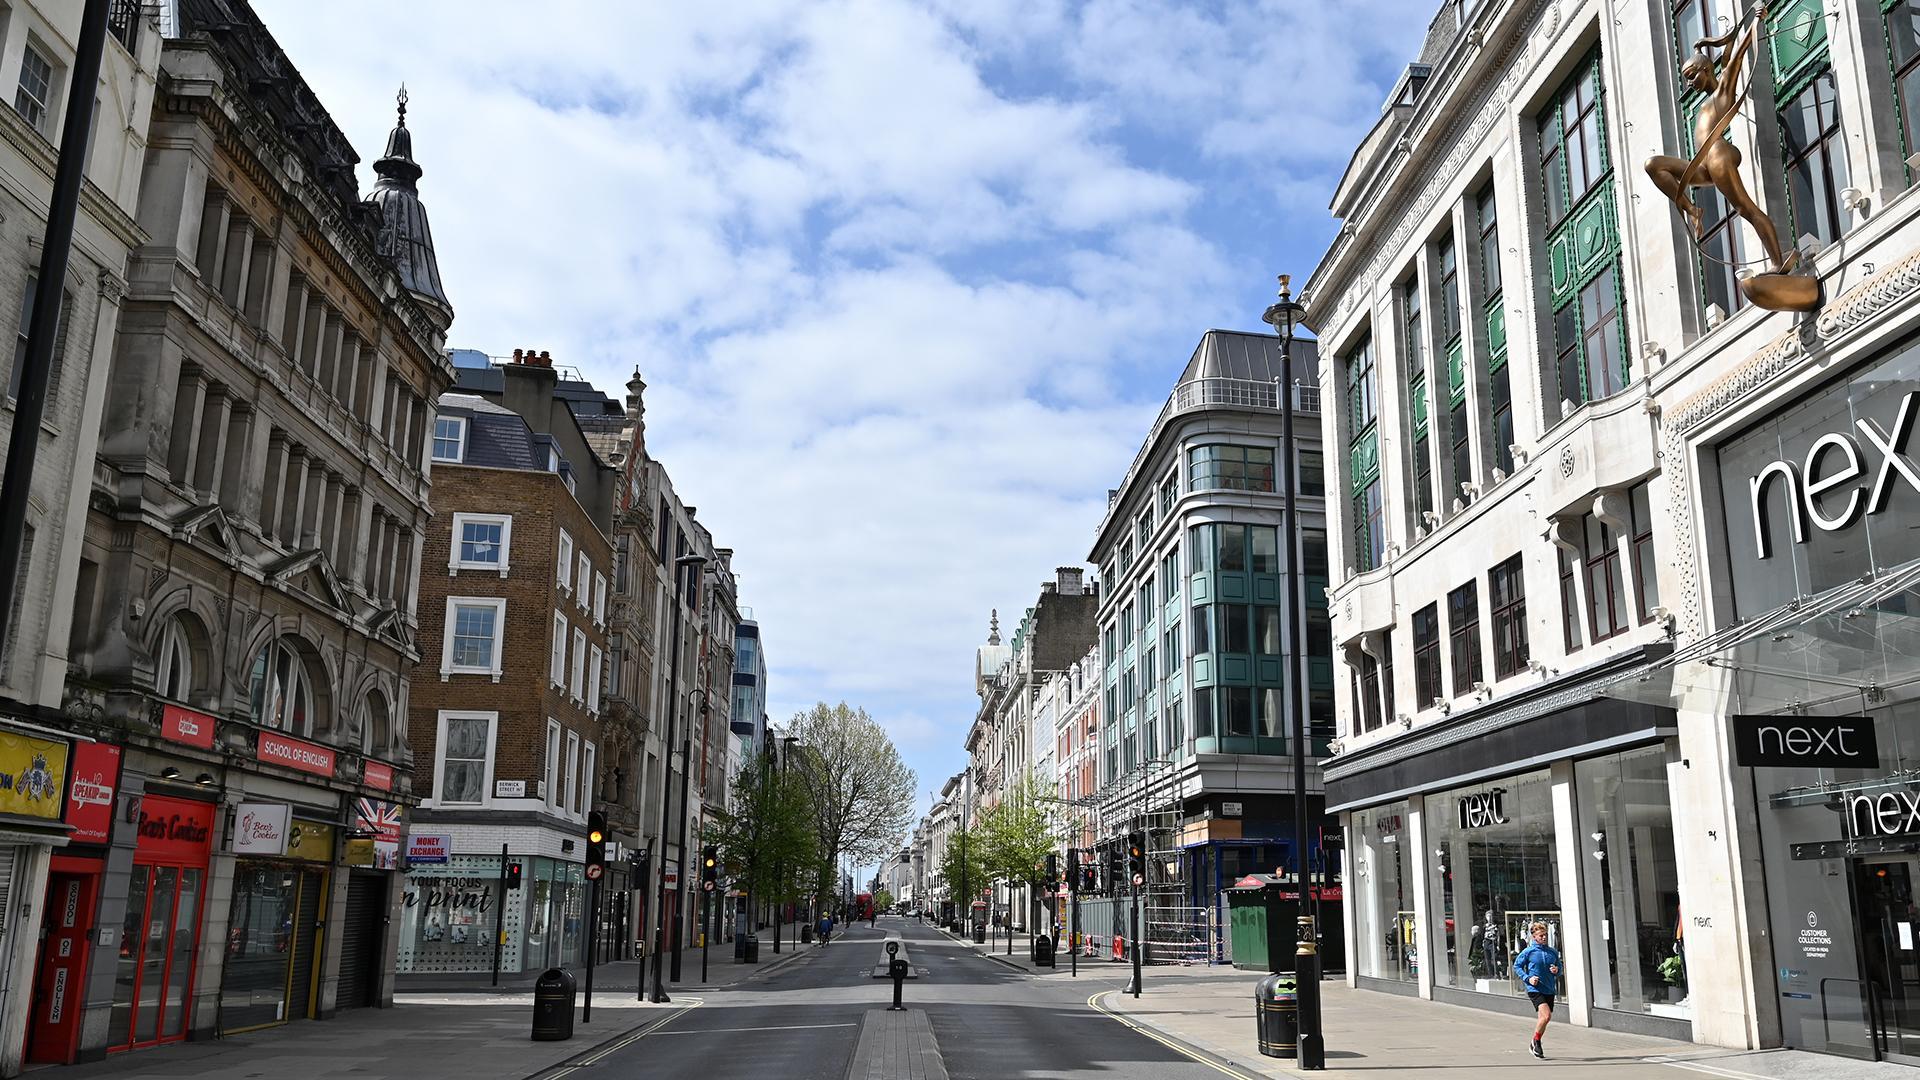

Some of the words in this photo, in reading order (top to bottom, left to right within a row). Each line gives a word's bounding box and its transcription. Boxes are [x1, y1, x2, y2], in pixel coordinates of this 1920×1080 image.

[1758, 726, 1859, 756] next
[265, 741, 292, 760] SCHOOL
[293, 750, 302, 761] OF
[302, 751, 328, 768] ENGLISH
[1457, 790, 1508, 829] next
[166, 814, 208, 843] Cookies
[252, 830, 279, 840] Cookies
[253, 821, 273, 831] Ben's
[410, 847, 445, 856] EXCHANGE
[416, 837, 440, 846] MONEY
[410, 876, 442, 887] YOUR
[445, 877, 482, 888] FOCUS
[66, 884, 78, 925] SCHOOL
[424, 885, 494, 917] print
[1800, 929, 1828, 937] CUSTOMER
[62, 940, 70, 955] OF
[51, 970, 65, 1020] ENGLISH
